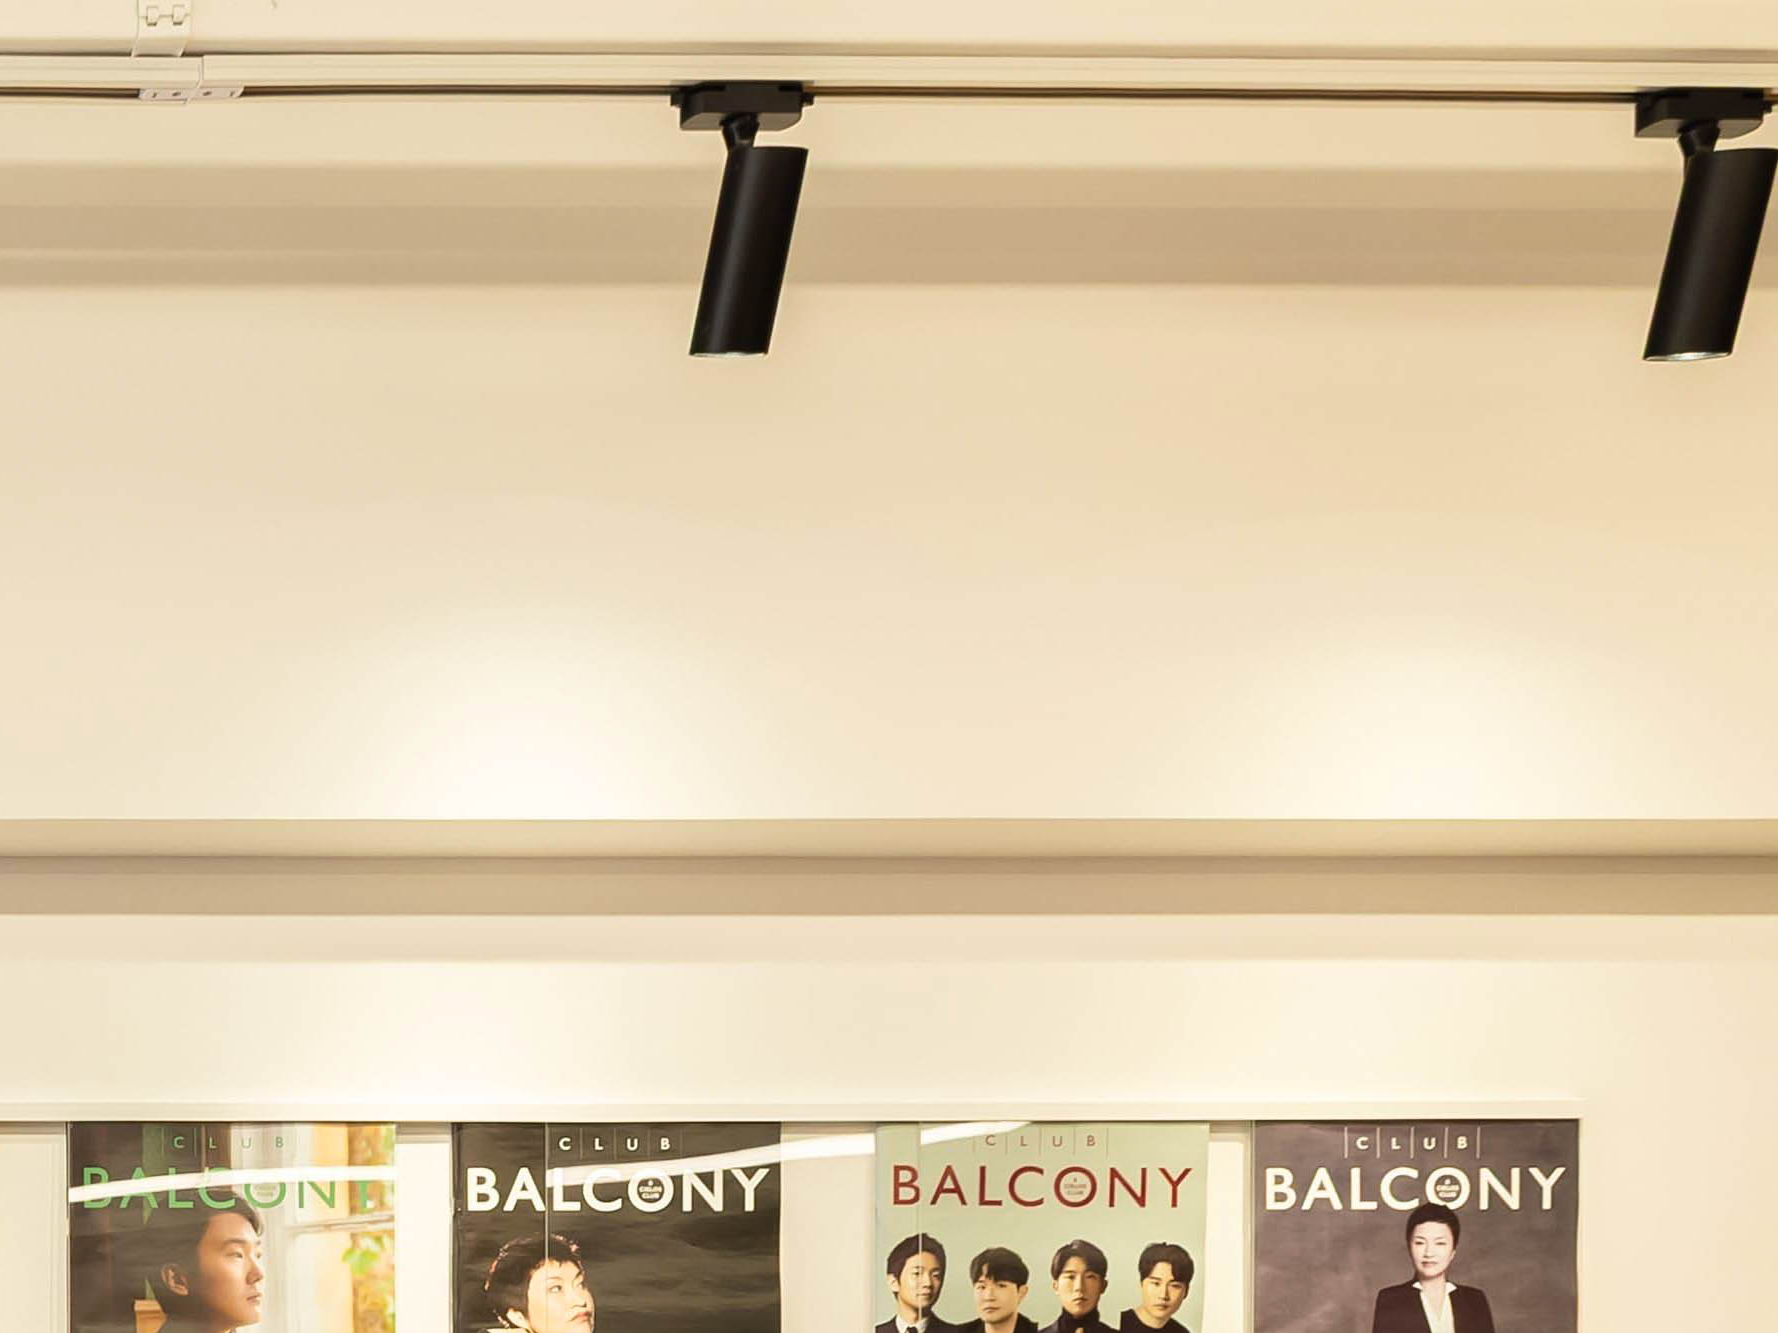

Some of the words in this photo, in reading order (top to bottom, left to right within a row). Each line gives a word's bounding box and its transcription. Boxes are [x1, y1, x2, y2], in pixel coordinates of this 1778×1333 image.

[174, 1136, 284, 1149] CLUB
[559, 1138, 671, 1151] CLUB
[986, 1134, 1096, 1147] CLUB
[1357, 1136, 1468, 1150] CLUB
[83, 1167, 384, 1209] BALCONY
[467, 1168, 770, 1212] BALCONY
[892, 1165, 1193, 1208] BALCONY
[1265, 1167, 1566, 1210] BALCONY
